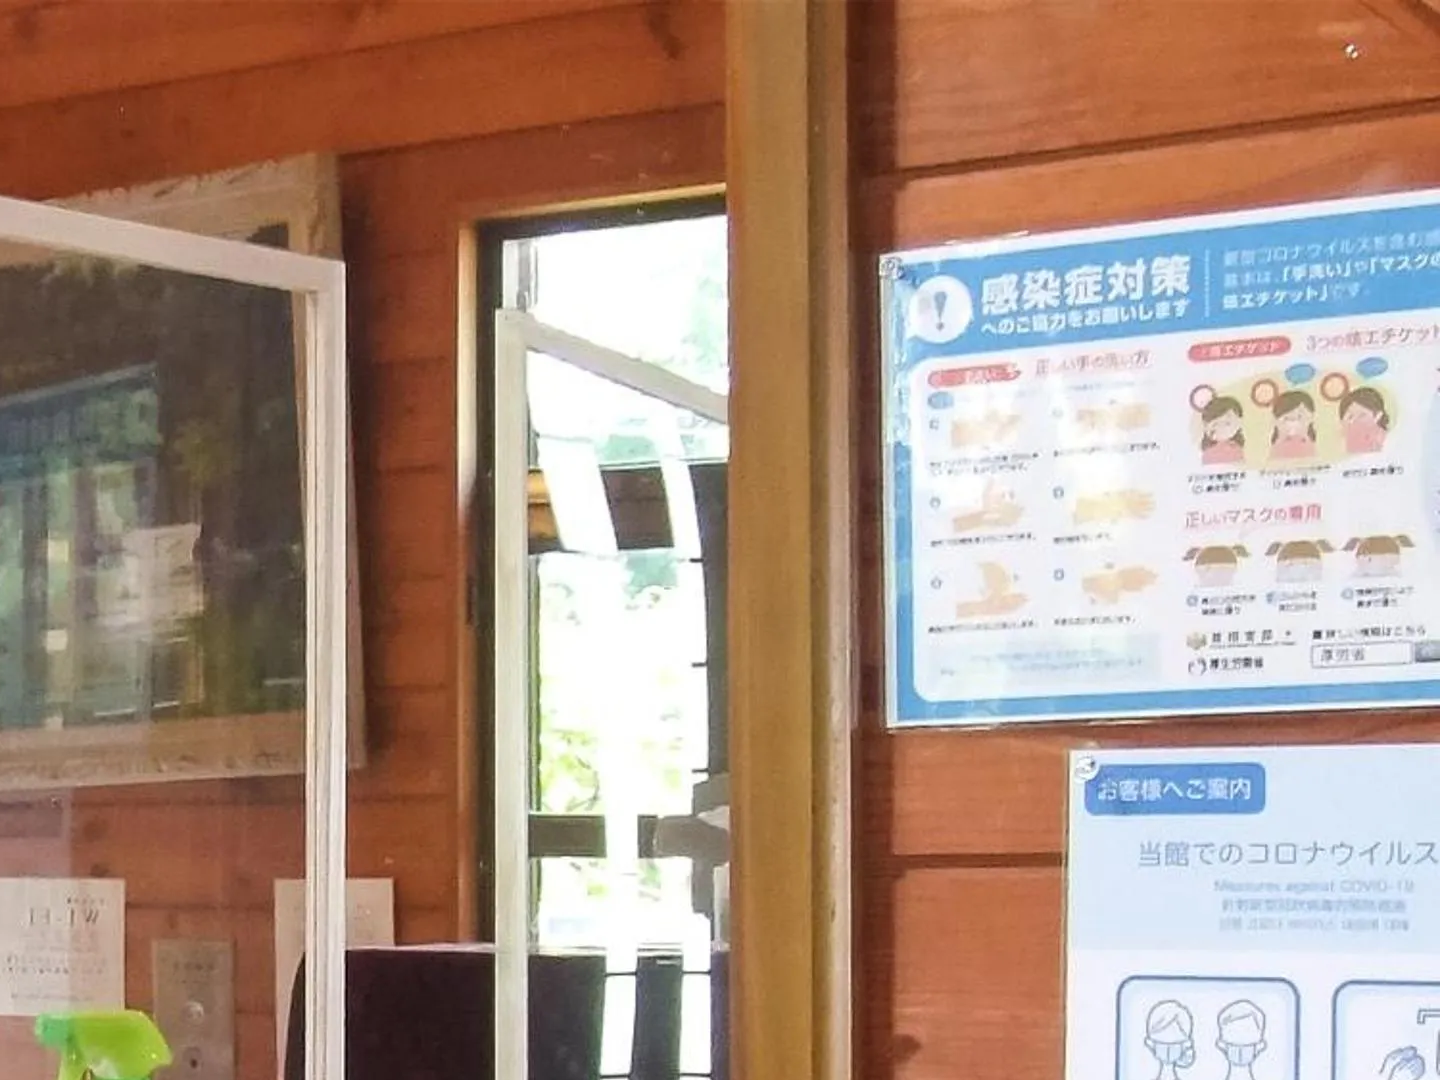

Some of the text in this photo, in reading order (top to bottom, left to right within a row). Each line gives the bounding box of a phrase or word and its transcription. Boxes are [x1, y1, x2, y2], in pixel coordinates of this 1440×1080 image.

[981, 254, 1191, 315] 感染症対策
[981, 298, 1190, 335] へのご協力をお願いします
[1097, 777, 1252, 801] お客様へご案内
[1138, 840, 1439, 868] 当館でのコロナウイルス
